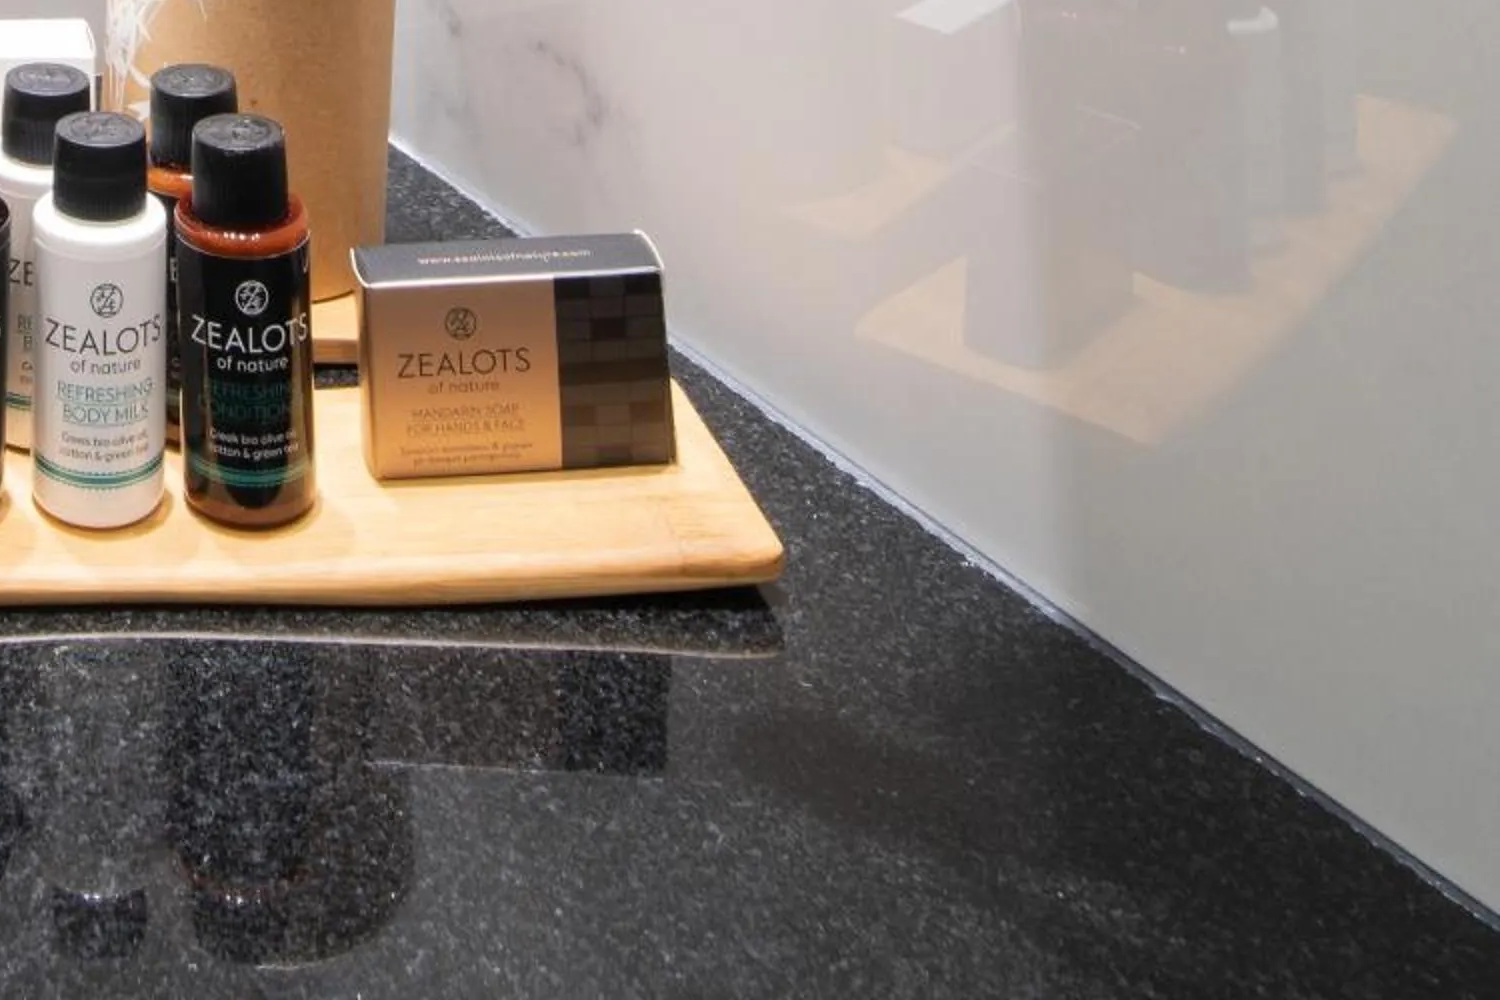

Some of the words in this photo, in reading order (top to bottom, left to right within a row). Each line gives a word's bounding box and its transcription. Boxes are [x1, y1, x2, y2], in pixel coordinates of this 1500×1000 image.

[44, 315, 161, 357] ZEALOTS
[191, 312, 308, 354] ZEALOTS
[70, 359, 85, 374] of
[91, 359, 141, 375] nature
[216, 355, 233, 371] of
[237, 356, 289, 373] nature
[396, 347, 532, 379] ZEALOTS
[57, 377, 153, 401] REFRESHING
[427, 381, 443, 395] of
[448, 380, 500, 394] nature
[63, 402, 110, 424] BODY
[114, 400, 149, 421] MILK
